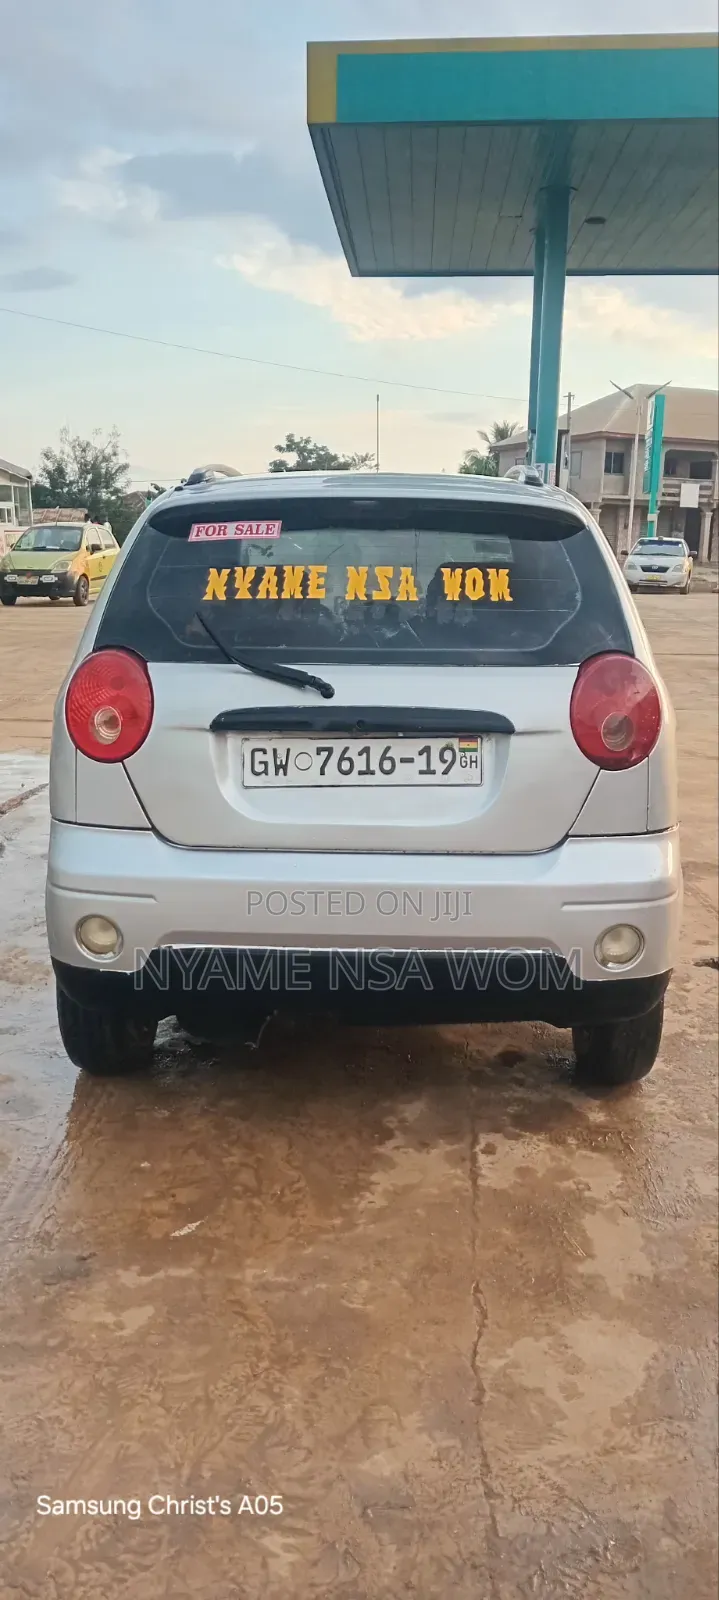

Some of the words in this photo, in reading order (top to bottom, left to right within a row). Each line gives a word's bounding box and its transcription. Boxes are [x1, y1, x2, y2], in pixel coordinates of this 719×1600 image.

[195, 523, 228, 537] FOR
[234, 523, 276, 536] SALE
[202, 565, 328, 601] NYAME
[345, 566, 419, 601] NSA
[440, 567, 513, 602] WOM
[250, 747, 291, 776] GW
[316, 745, 457, 776] 7616-19
[459, 757, 478, 769] GH
